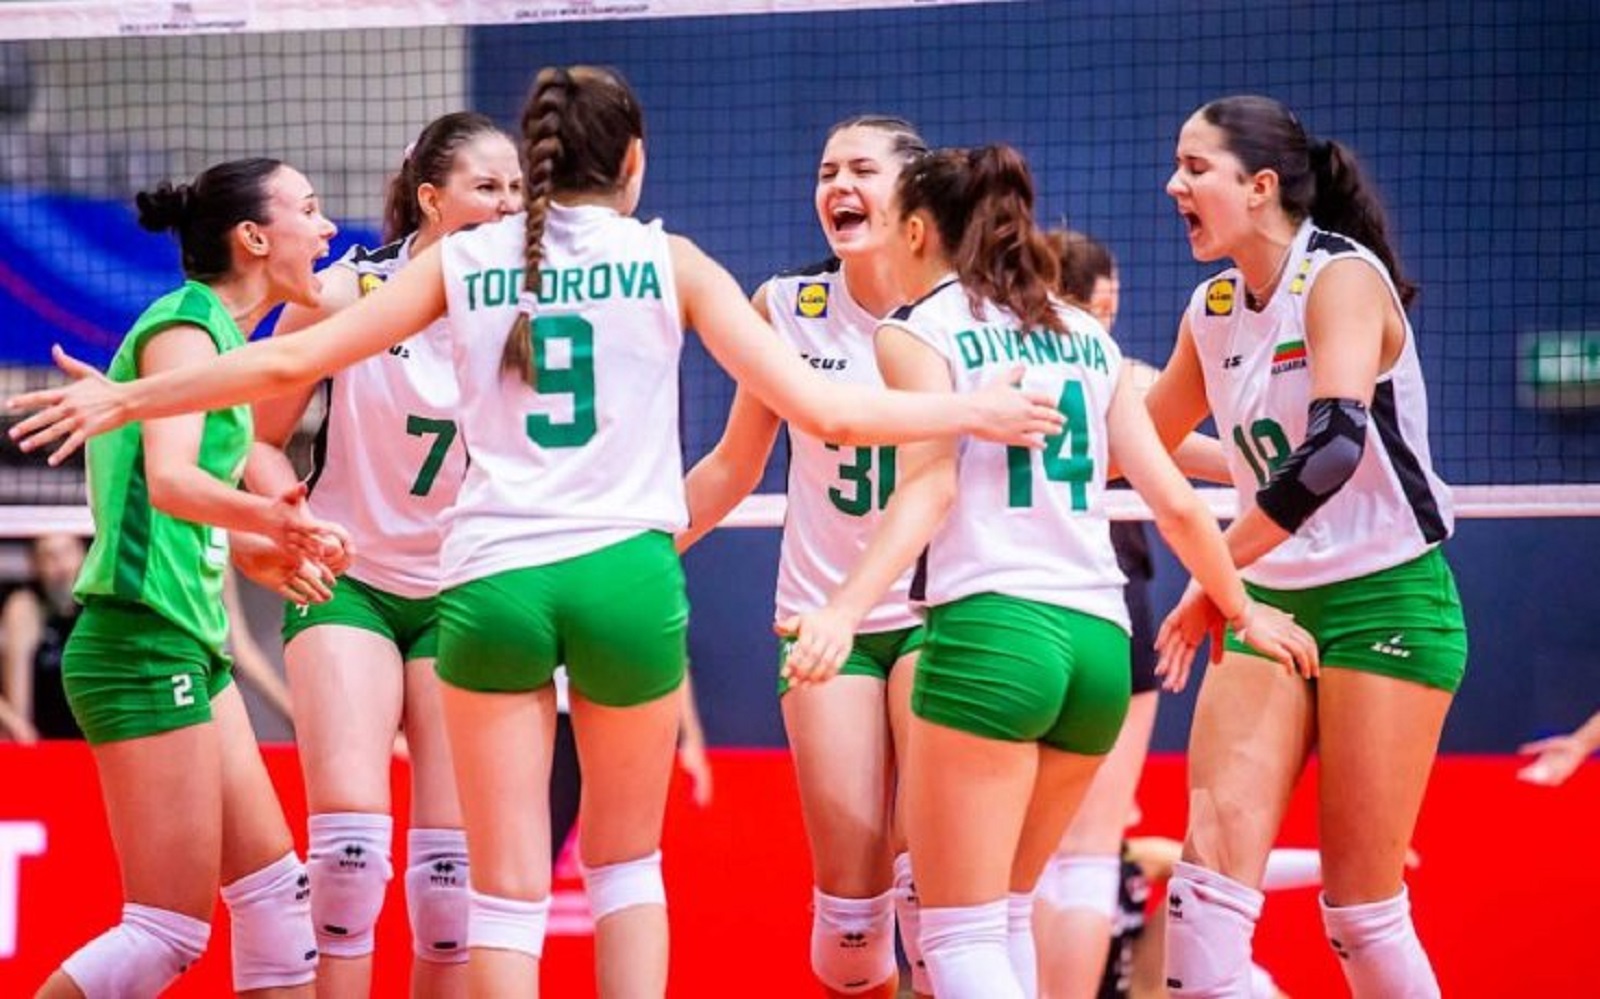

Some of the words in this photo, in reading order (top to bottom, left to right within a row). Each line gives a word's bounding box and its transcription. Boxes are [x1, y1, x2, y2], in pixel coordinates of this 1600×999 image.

[525, 313, 597, 449] 9
[955, 328, 1109, 375] DIVANOVA
[406, 414, 457, 496] 7
[171, 673, 195, 707] 2
